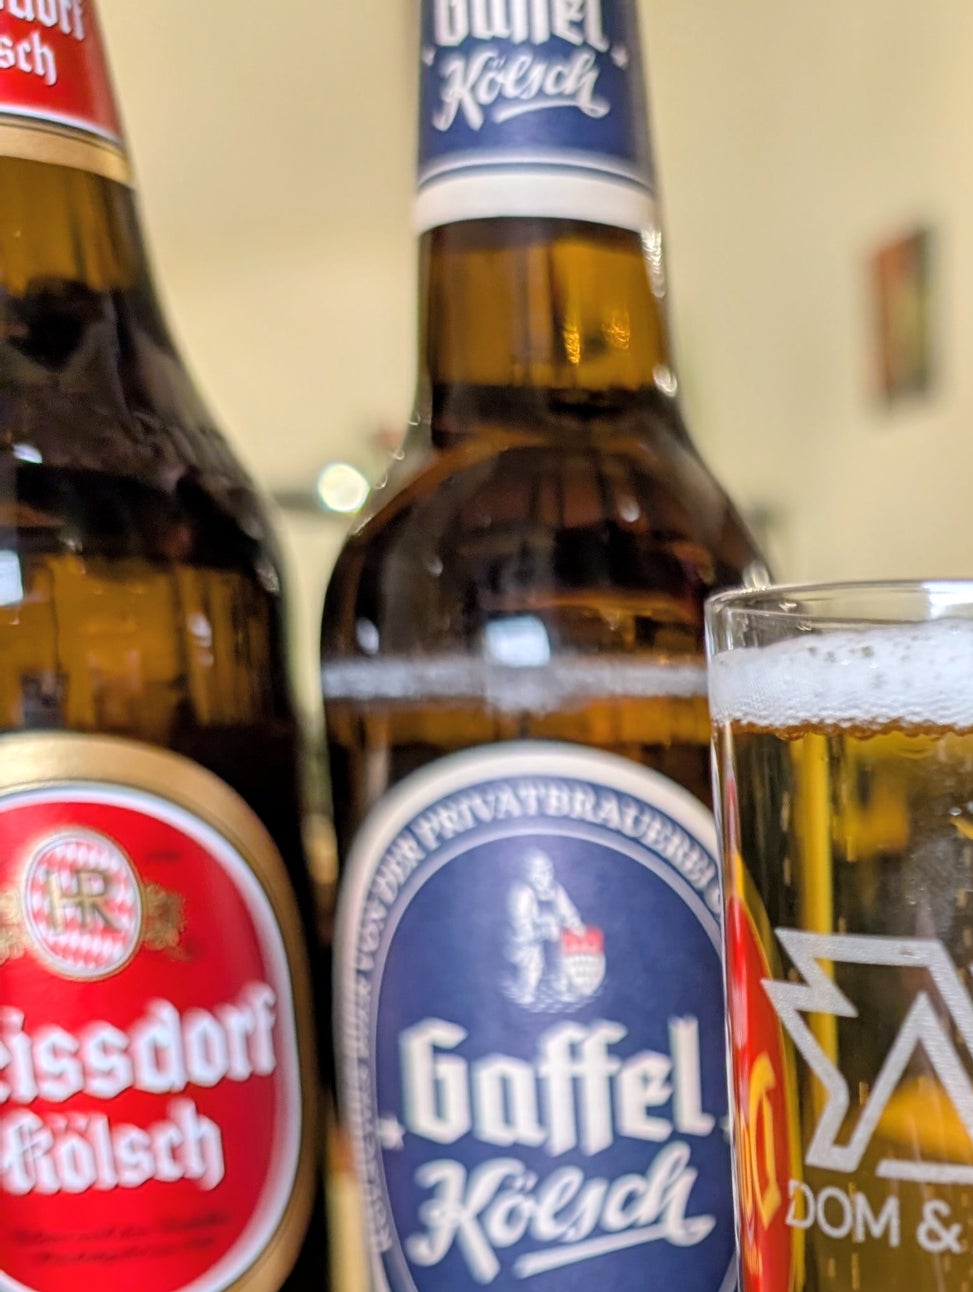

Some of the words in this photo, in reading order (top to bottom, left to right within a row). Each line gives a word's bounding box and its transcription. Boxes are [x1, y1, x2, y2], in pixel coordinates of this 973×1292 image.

[0, 30, 58, 86] sch
[432, 49, 611, 131] Kölsch
[0, 978, 278, 1105] issdorf
[400, 1014, 716, 1157] Gaffel
[0, 1096, 226, 1195] Kölsch
[404, 1140, 716, 1285] Kölsch
[785, 1179, 900, 1248] DOM
[916, 1199, 964, 1254] &
